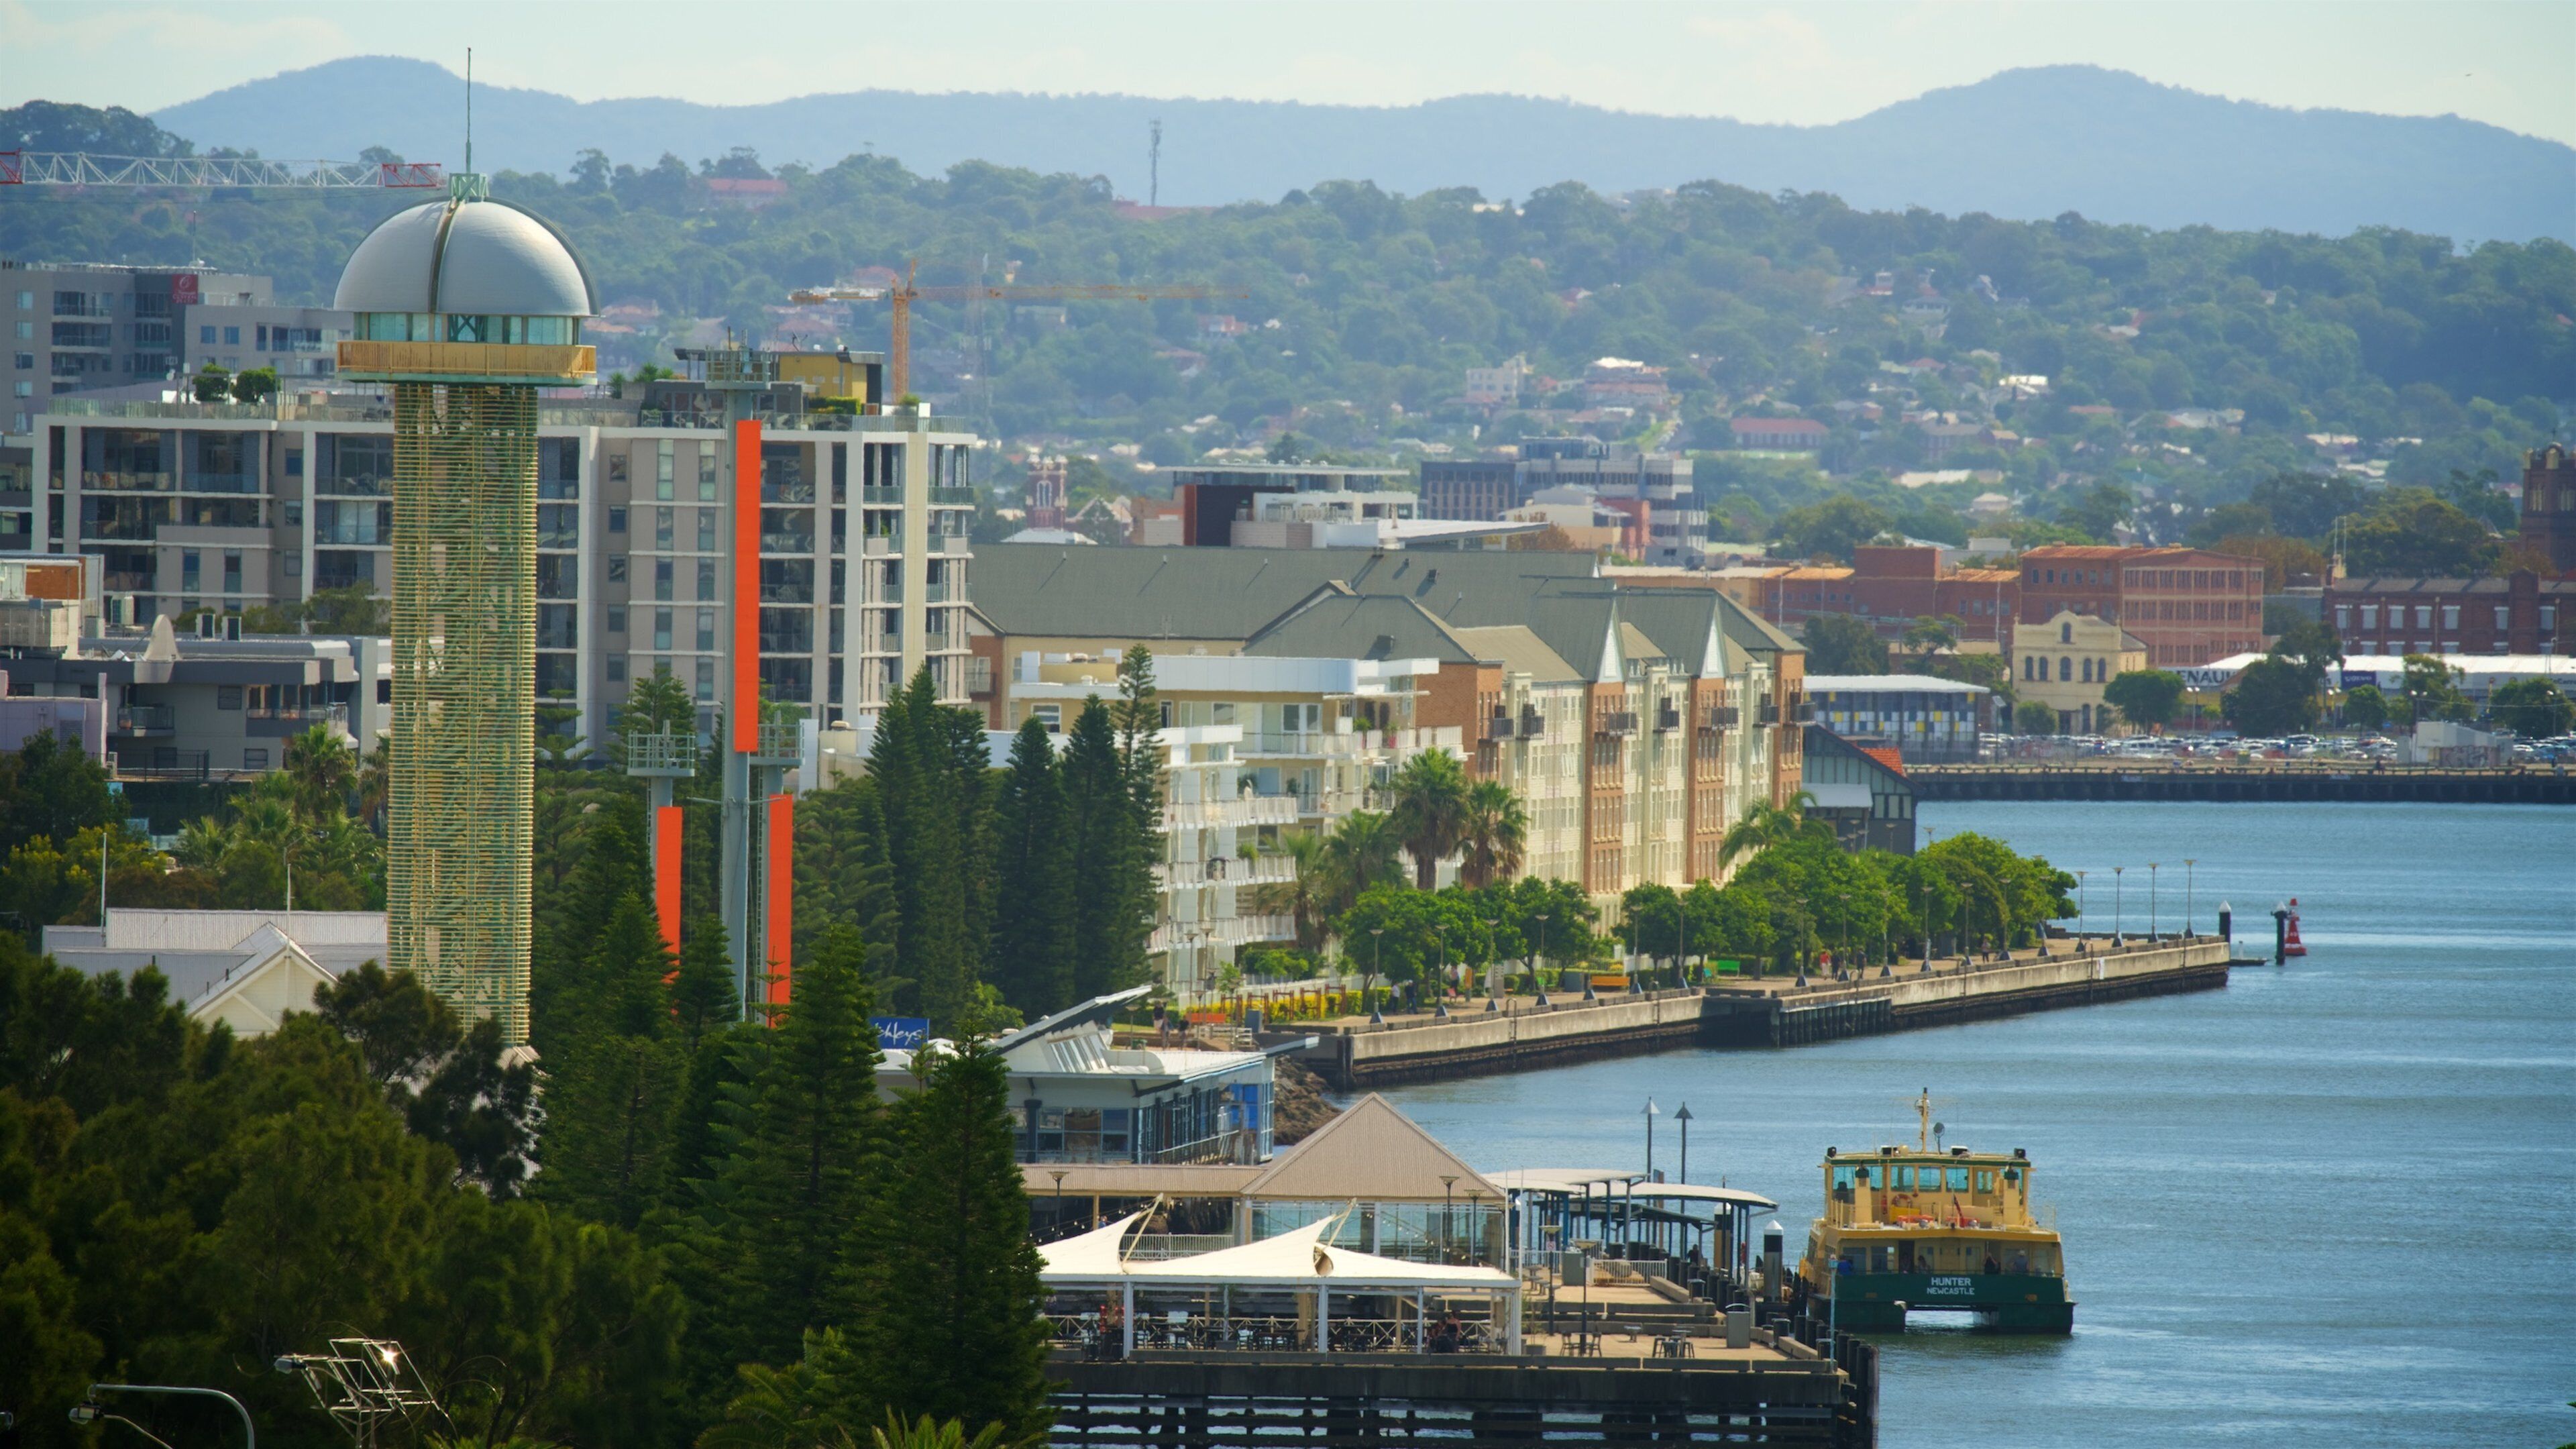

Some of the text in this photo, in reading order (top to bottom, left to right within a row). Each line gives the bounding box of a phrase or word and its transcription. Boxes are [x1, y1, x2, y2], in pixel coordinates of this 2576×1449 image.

[2176, 670, 2237, 683] ENAU
[1931, 1277, 1971, 1286] HUNTER
[1927, 1287, 1975, 1295] NEWCASTLE
